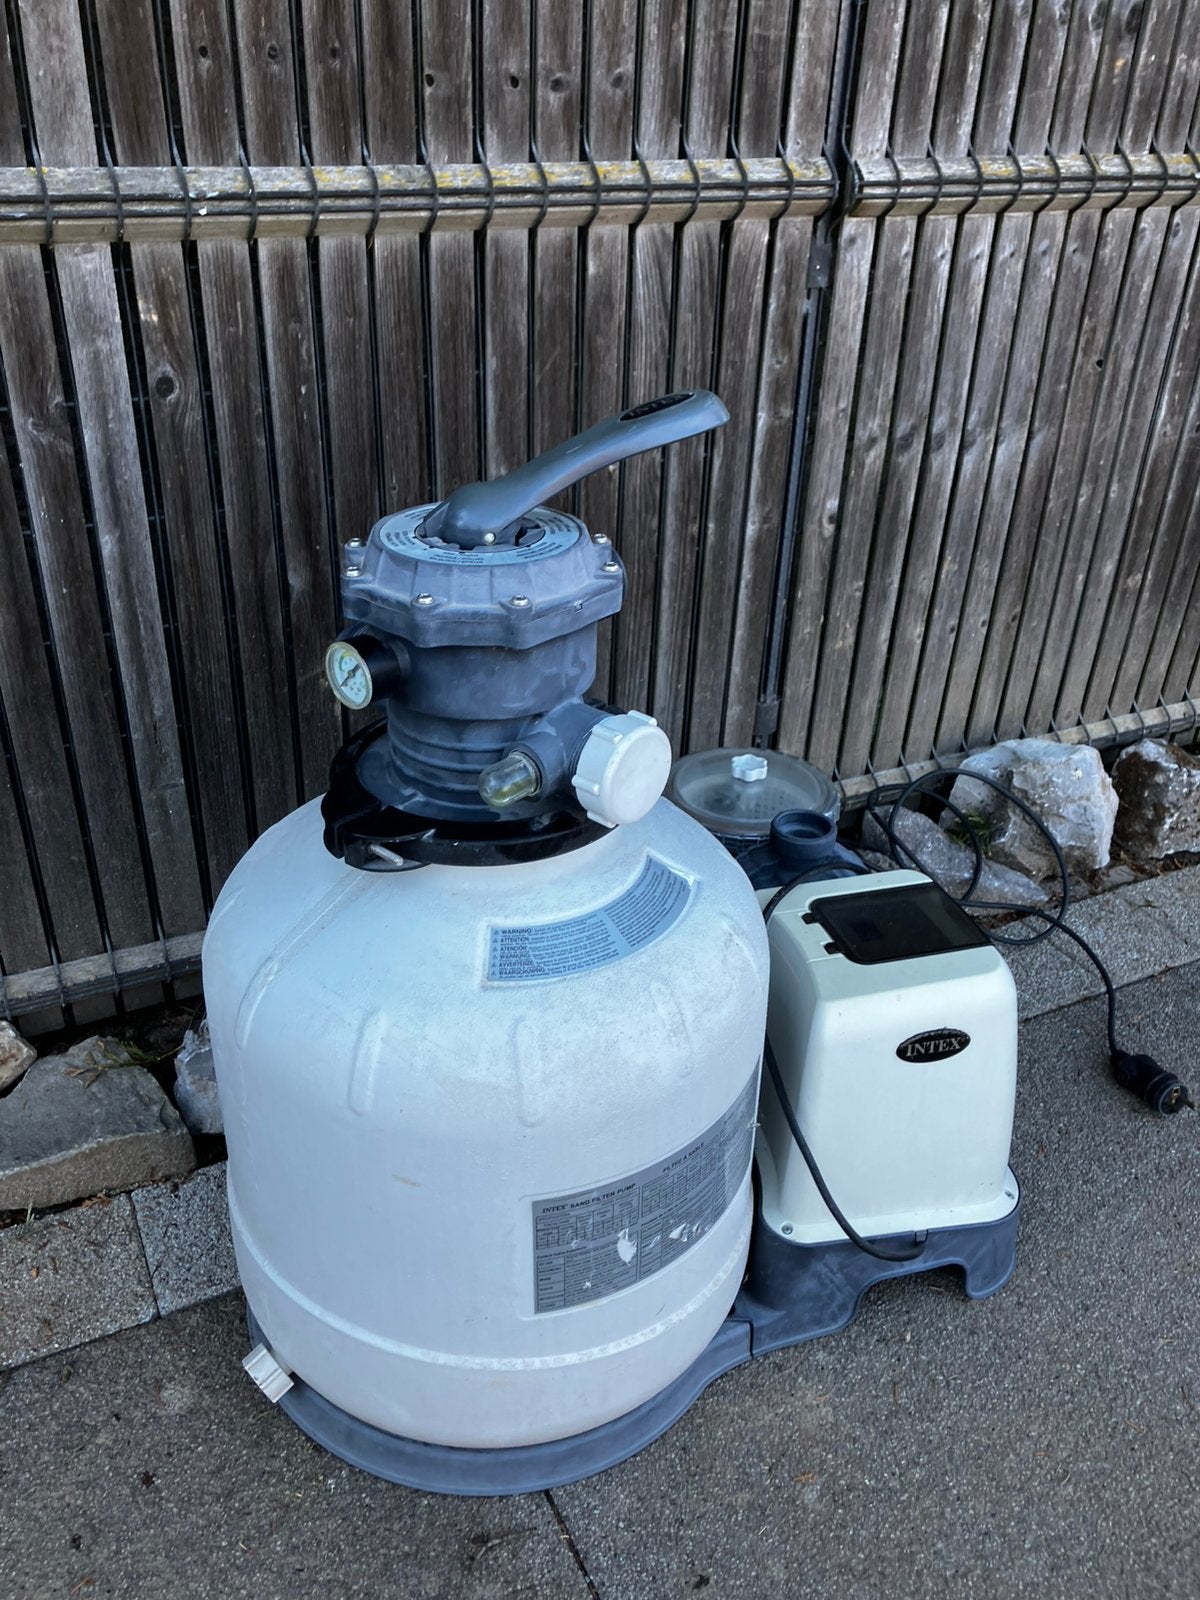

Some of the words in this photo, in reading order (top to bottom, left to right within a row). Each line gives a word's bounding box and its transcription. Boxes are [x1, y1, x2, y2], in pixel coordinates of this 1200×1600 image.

[905, 1036, 961, 1057] INTEX
[570, 1199, 590, 1209] SAND
[592, 1191, 615, 1203] FILTER
[616, 1183, 636, 1195] PUMP
